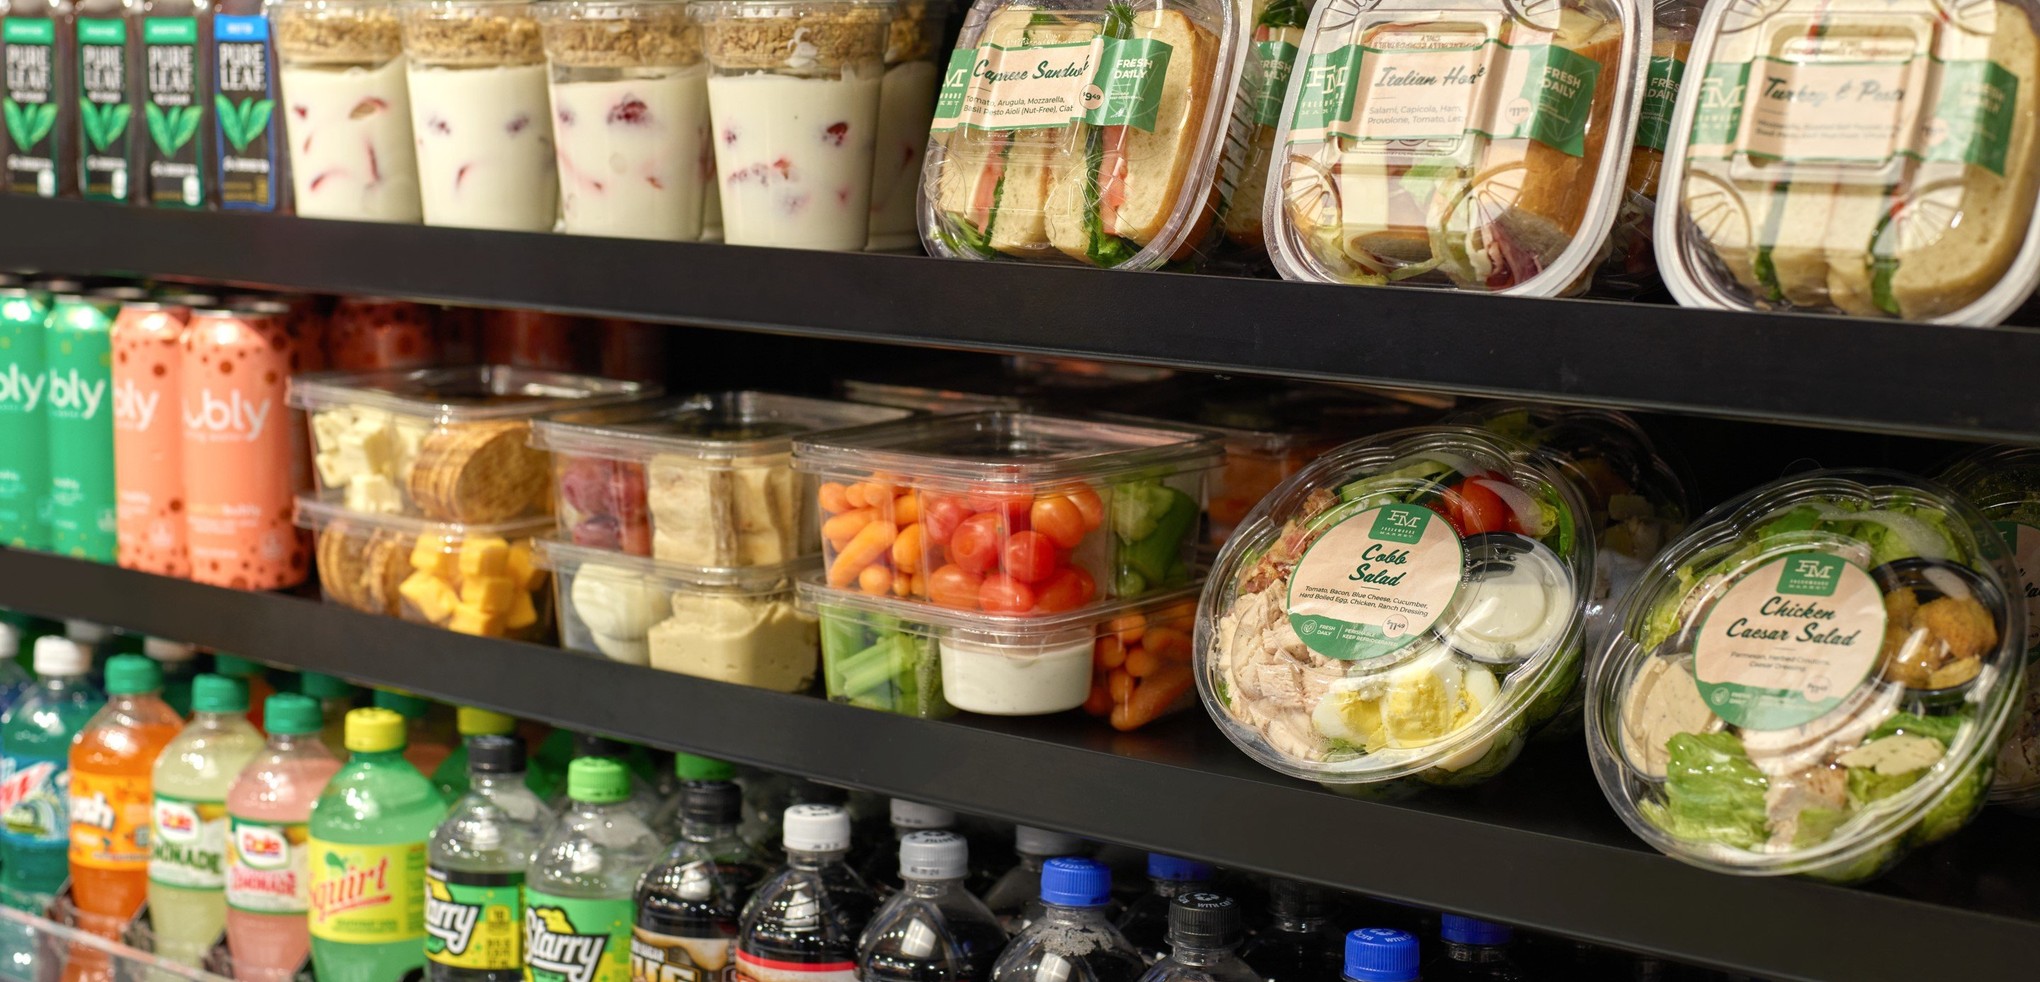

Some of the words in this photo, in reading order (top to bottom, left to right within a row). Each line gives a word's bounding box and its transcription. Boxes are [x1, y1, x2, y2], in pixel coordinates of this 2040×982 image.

[82, 45, 124, 67] PURE
[148, 45, 194, 67] PURE
[218, 43, 265, 65] PURE
[1115, 58, 1153, 69] FRESH
[84, 66, 125, 91] LEAF
[149, 66, 196, 92] LEAF
[220, 64, 267, 91] LEAF
[1113, 69, 1147, 79] DAILY
[1374, 66, 1437, 87] Italian
[1545, 65, 1582, 89] FRESH
[1651, 77, 1681, 93] FRES
[1541, 78, 1576, 99] DAILY
[1647, 88, 1676, 104] DAIL
[1361, 544, 1410, 565] Cobb
[1348, 563, 1407, 586] Salad
[1305, 585, 1329, 594] Tomato,
[1329, 588, 1350, 597] Bacon,
[1351, 591, 1367, 599] Blue
[1367, 593, 1392, 604] Cheese,
[1392, 597, 1429, 610] Cucumber,
[1314, 593, 1335, 602] Boiled
[1349, 598, 1377, 609] Chicken,
[1377, 602, 1399, 612] Ranch
[1399, 606, 1429, 618] Dressing
[1760, 596, 1837, 620] Chicken
[1726, 617, 1789, 641] Caesar
[1795, 621, 1861, 647] Salad
[244, 832, 280, 857] Dole
[522, 906, 606, 982] Starry
